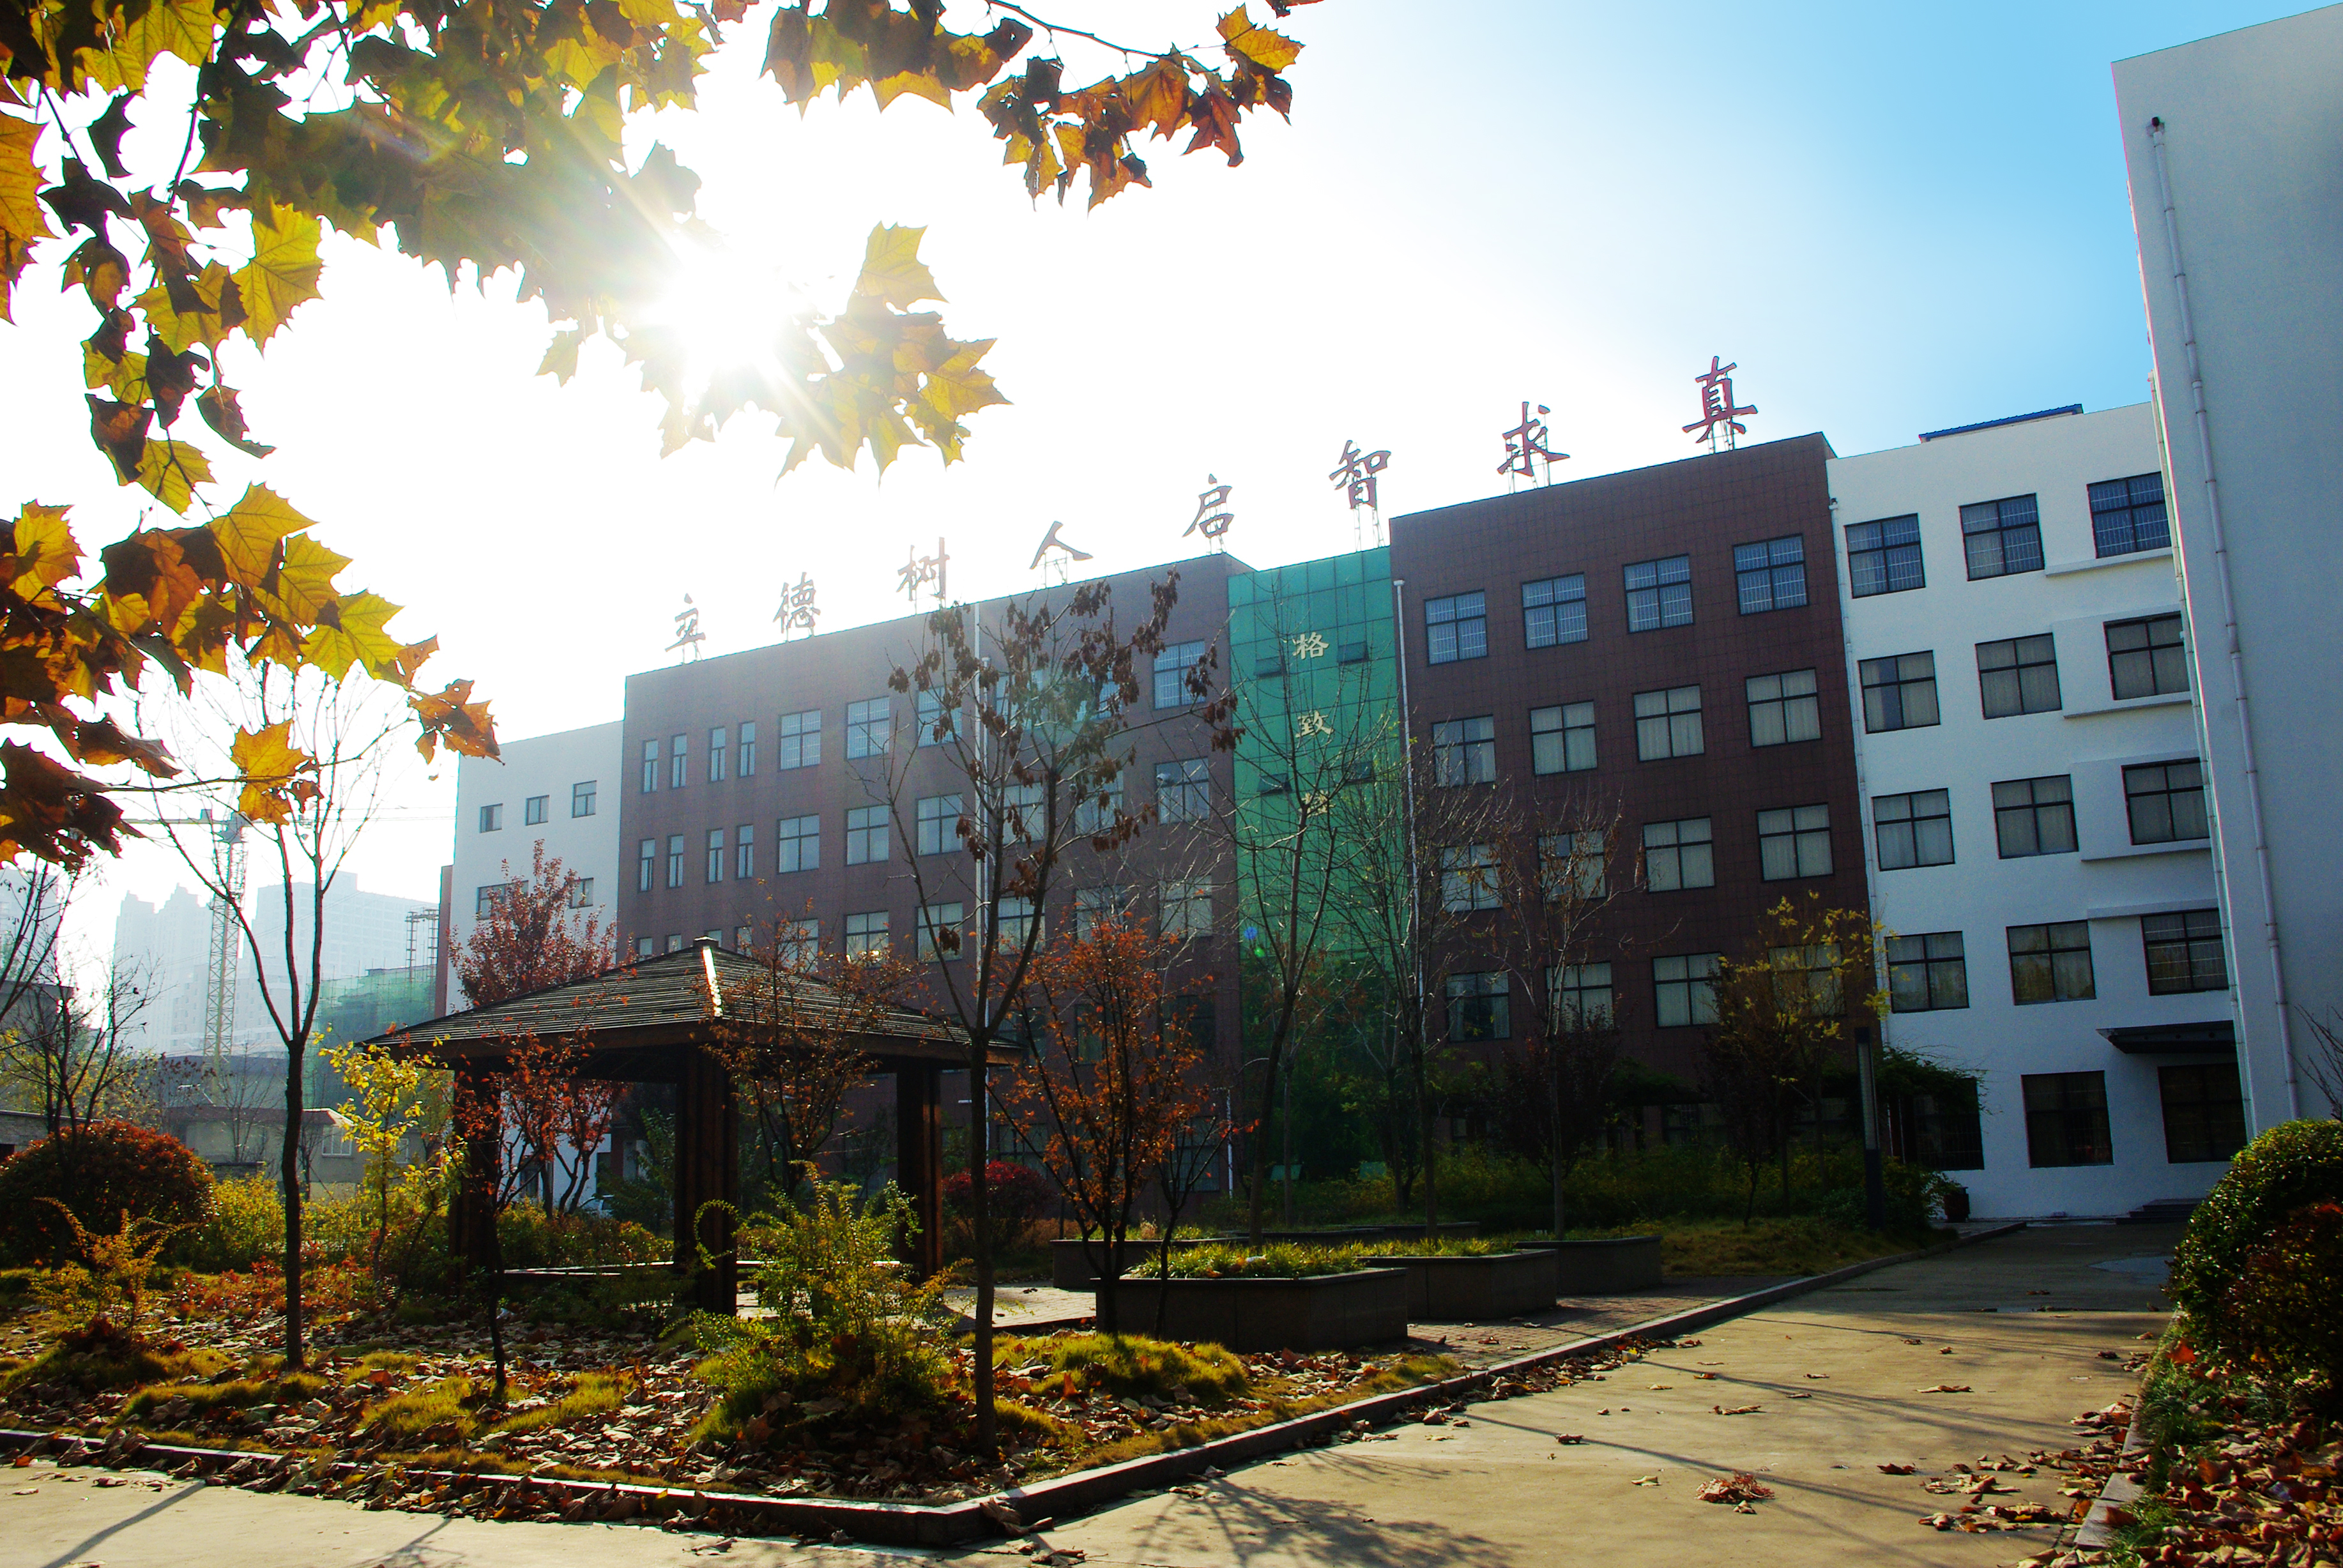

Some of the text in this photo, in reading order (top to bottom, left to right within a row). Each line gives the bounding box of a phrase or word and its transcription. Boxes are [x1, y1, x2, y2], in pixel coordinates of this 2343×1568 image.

[665, 356, 1758, 652] 立德树人启智求真
